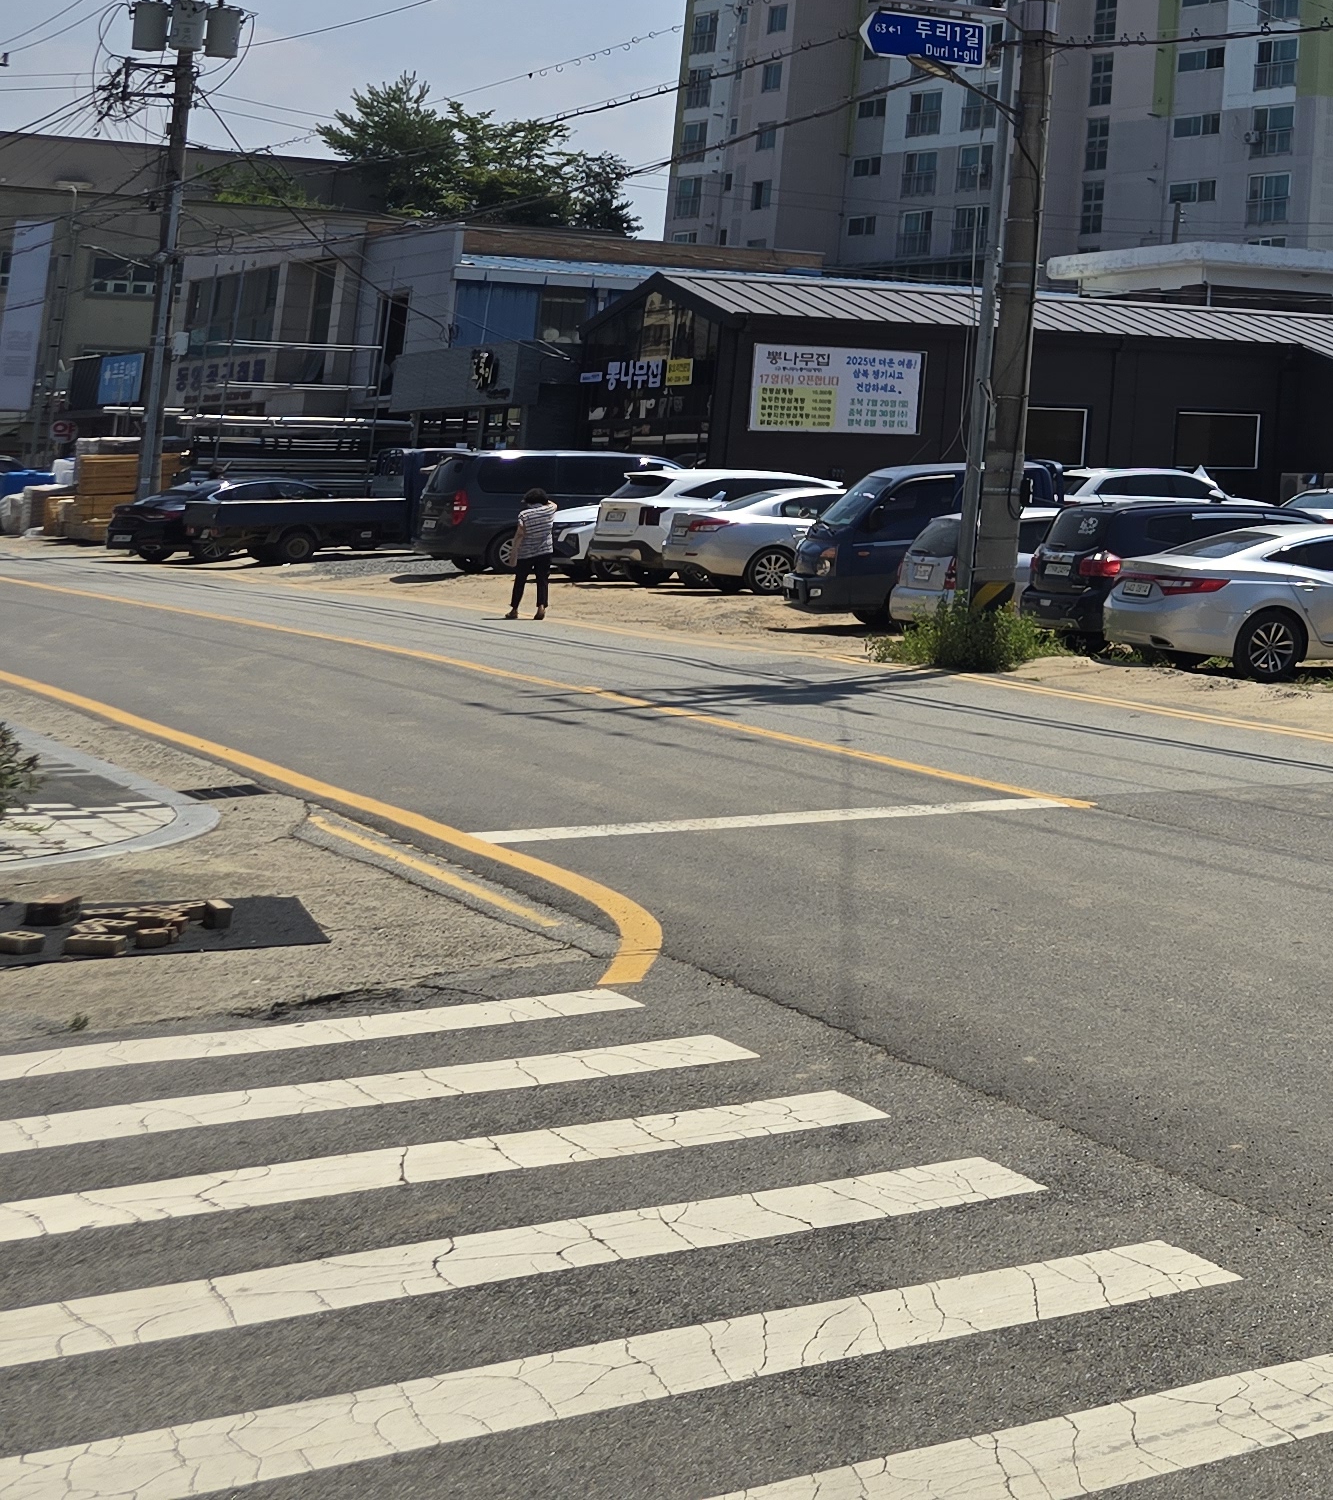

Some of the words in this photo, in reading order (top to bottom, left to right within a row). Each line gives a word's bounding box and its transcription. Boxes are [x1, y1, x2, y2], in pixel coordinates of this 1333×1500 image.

[915, 20, 979, 48] 두리1길
[846, 356, 876, 367] 2025년
[797, 374, 839, 387] 오픈합니다
[856, 382, 902, 394] 건강하세요.
[52, 421, 76, 441] 약
